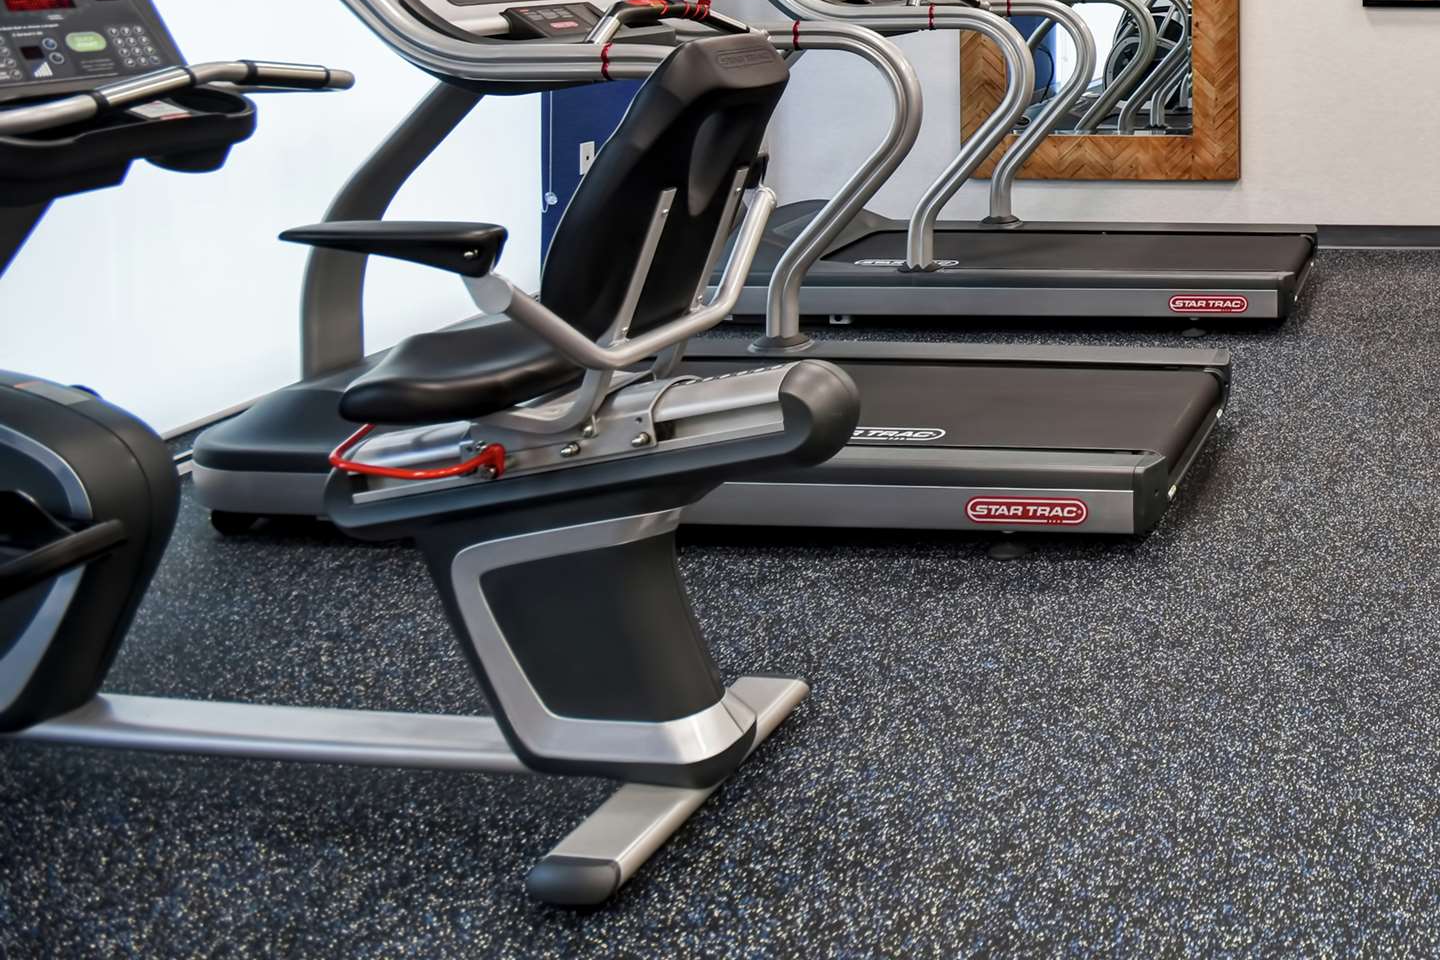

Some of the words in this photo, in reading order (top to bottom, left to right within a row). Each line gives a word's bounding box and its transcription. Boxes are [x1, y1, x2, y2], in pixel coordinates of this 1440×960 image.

[1173, 300, 1206, 308] STAR
[1208, 300, 1241, 308] TRAC
[867, 430, 935, 438] TRAC
[972, 505, 1023, 516] STAR
[1026, 506, 1077, 517] TRAC
